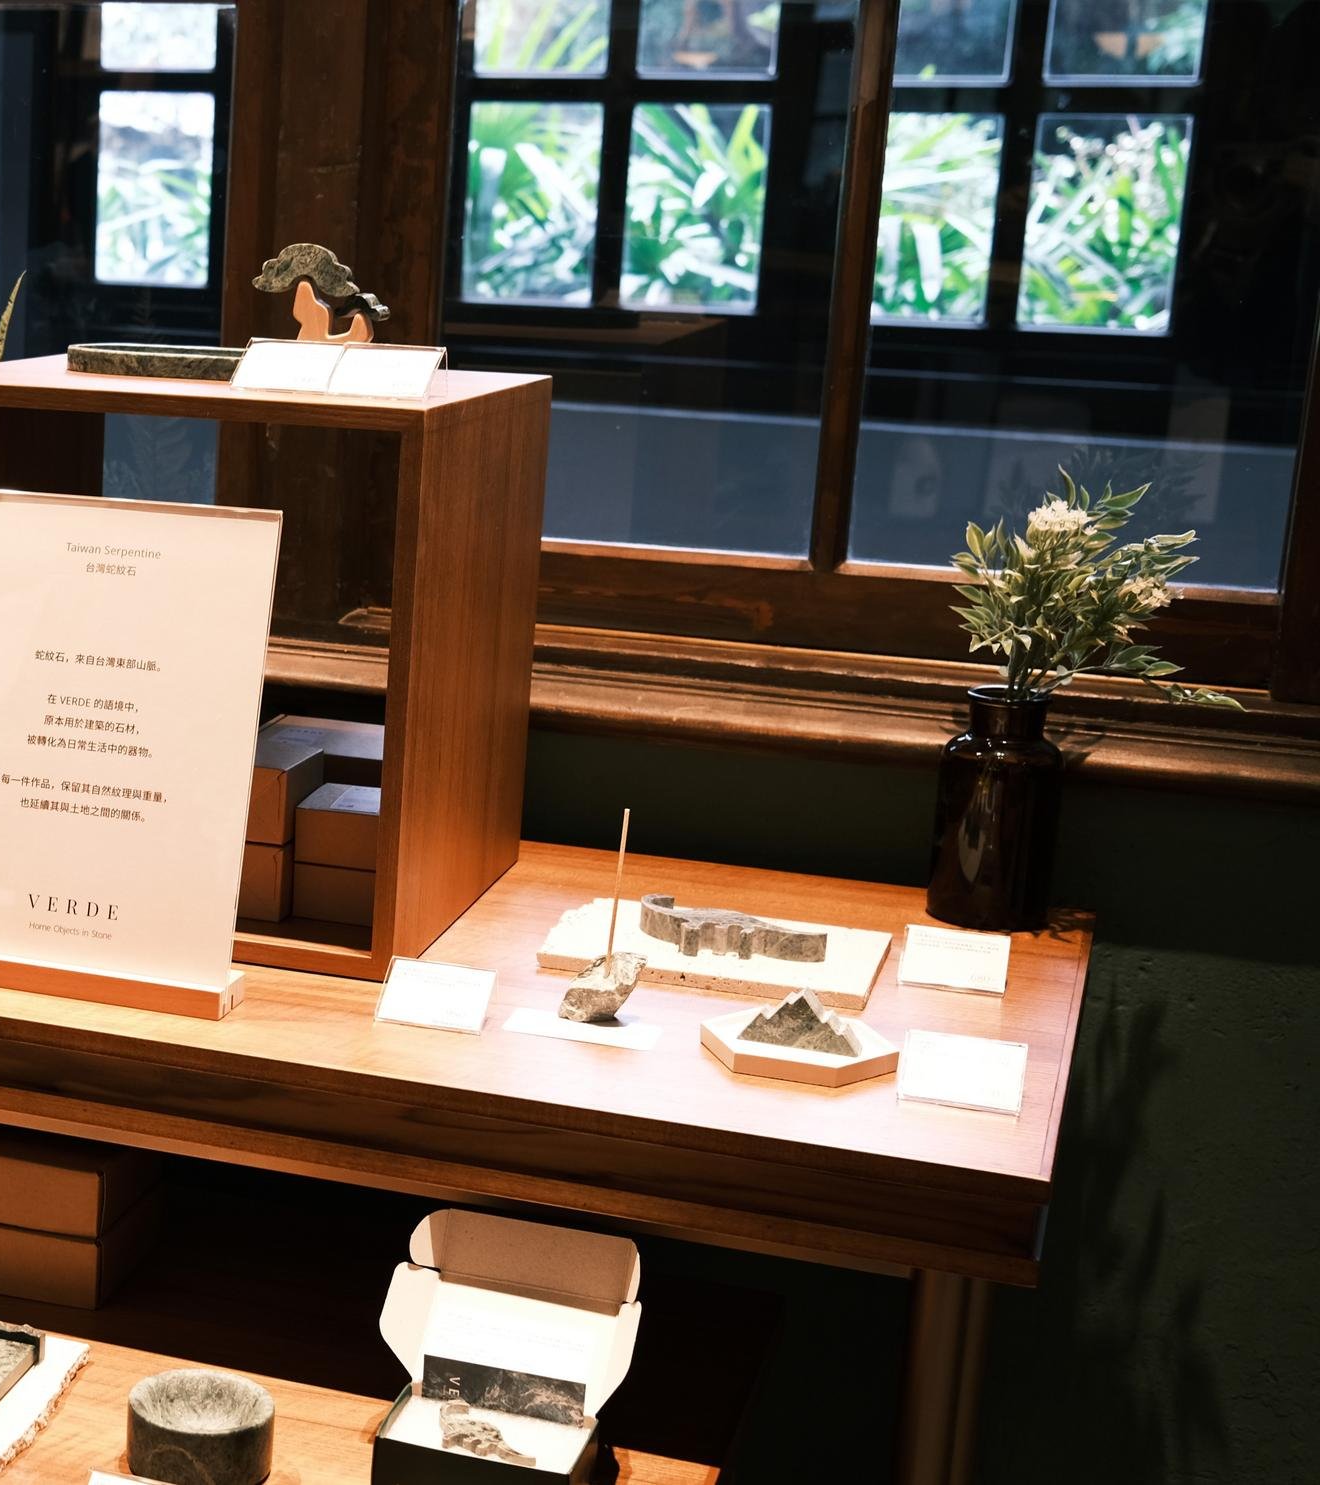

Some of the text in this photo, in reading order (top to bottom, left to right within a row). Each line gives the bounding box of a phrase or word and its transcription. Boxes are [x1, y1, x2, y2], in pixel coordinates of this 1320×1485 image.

[66, 542, 162, 559] Taiwan Serpentine
[86, 562, 137, 576] 台灣蛇紋石
[47, 693, 57, 704] 在
[60, 696, 91, 708] VERDE
[44, 715, 140, 735] 原本用於建築的石材，
[27, 734, 153, 758] 被轉化為日常生活中的器物。
[29, 893, 119, 920] VERDE
[28, 921, 112, 940] Home Objects in Stone
